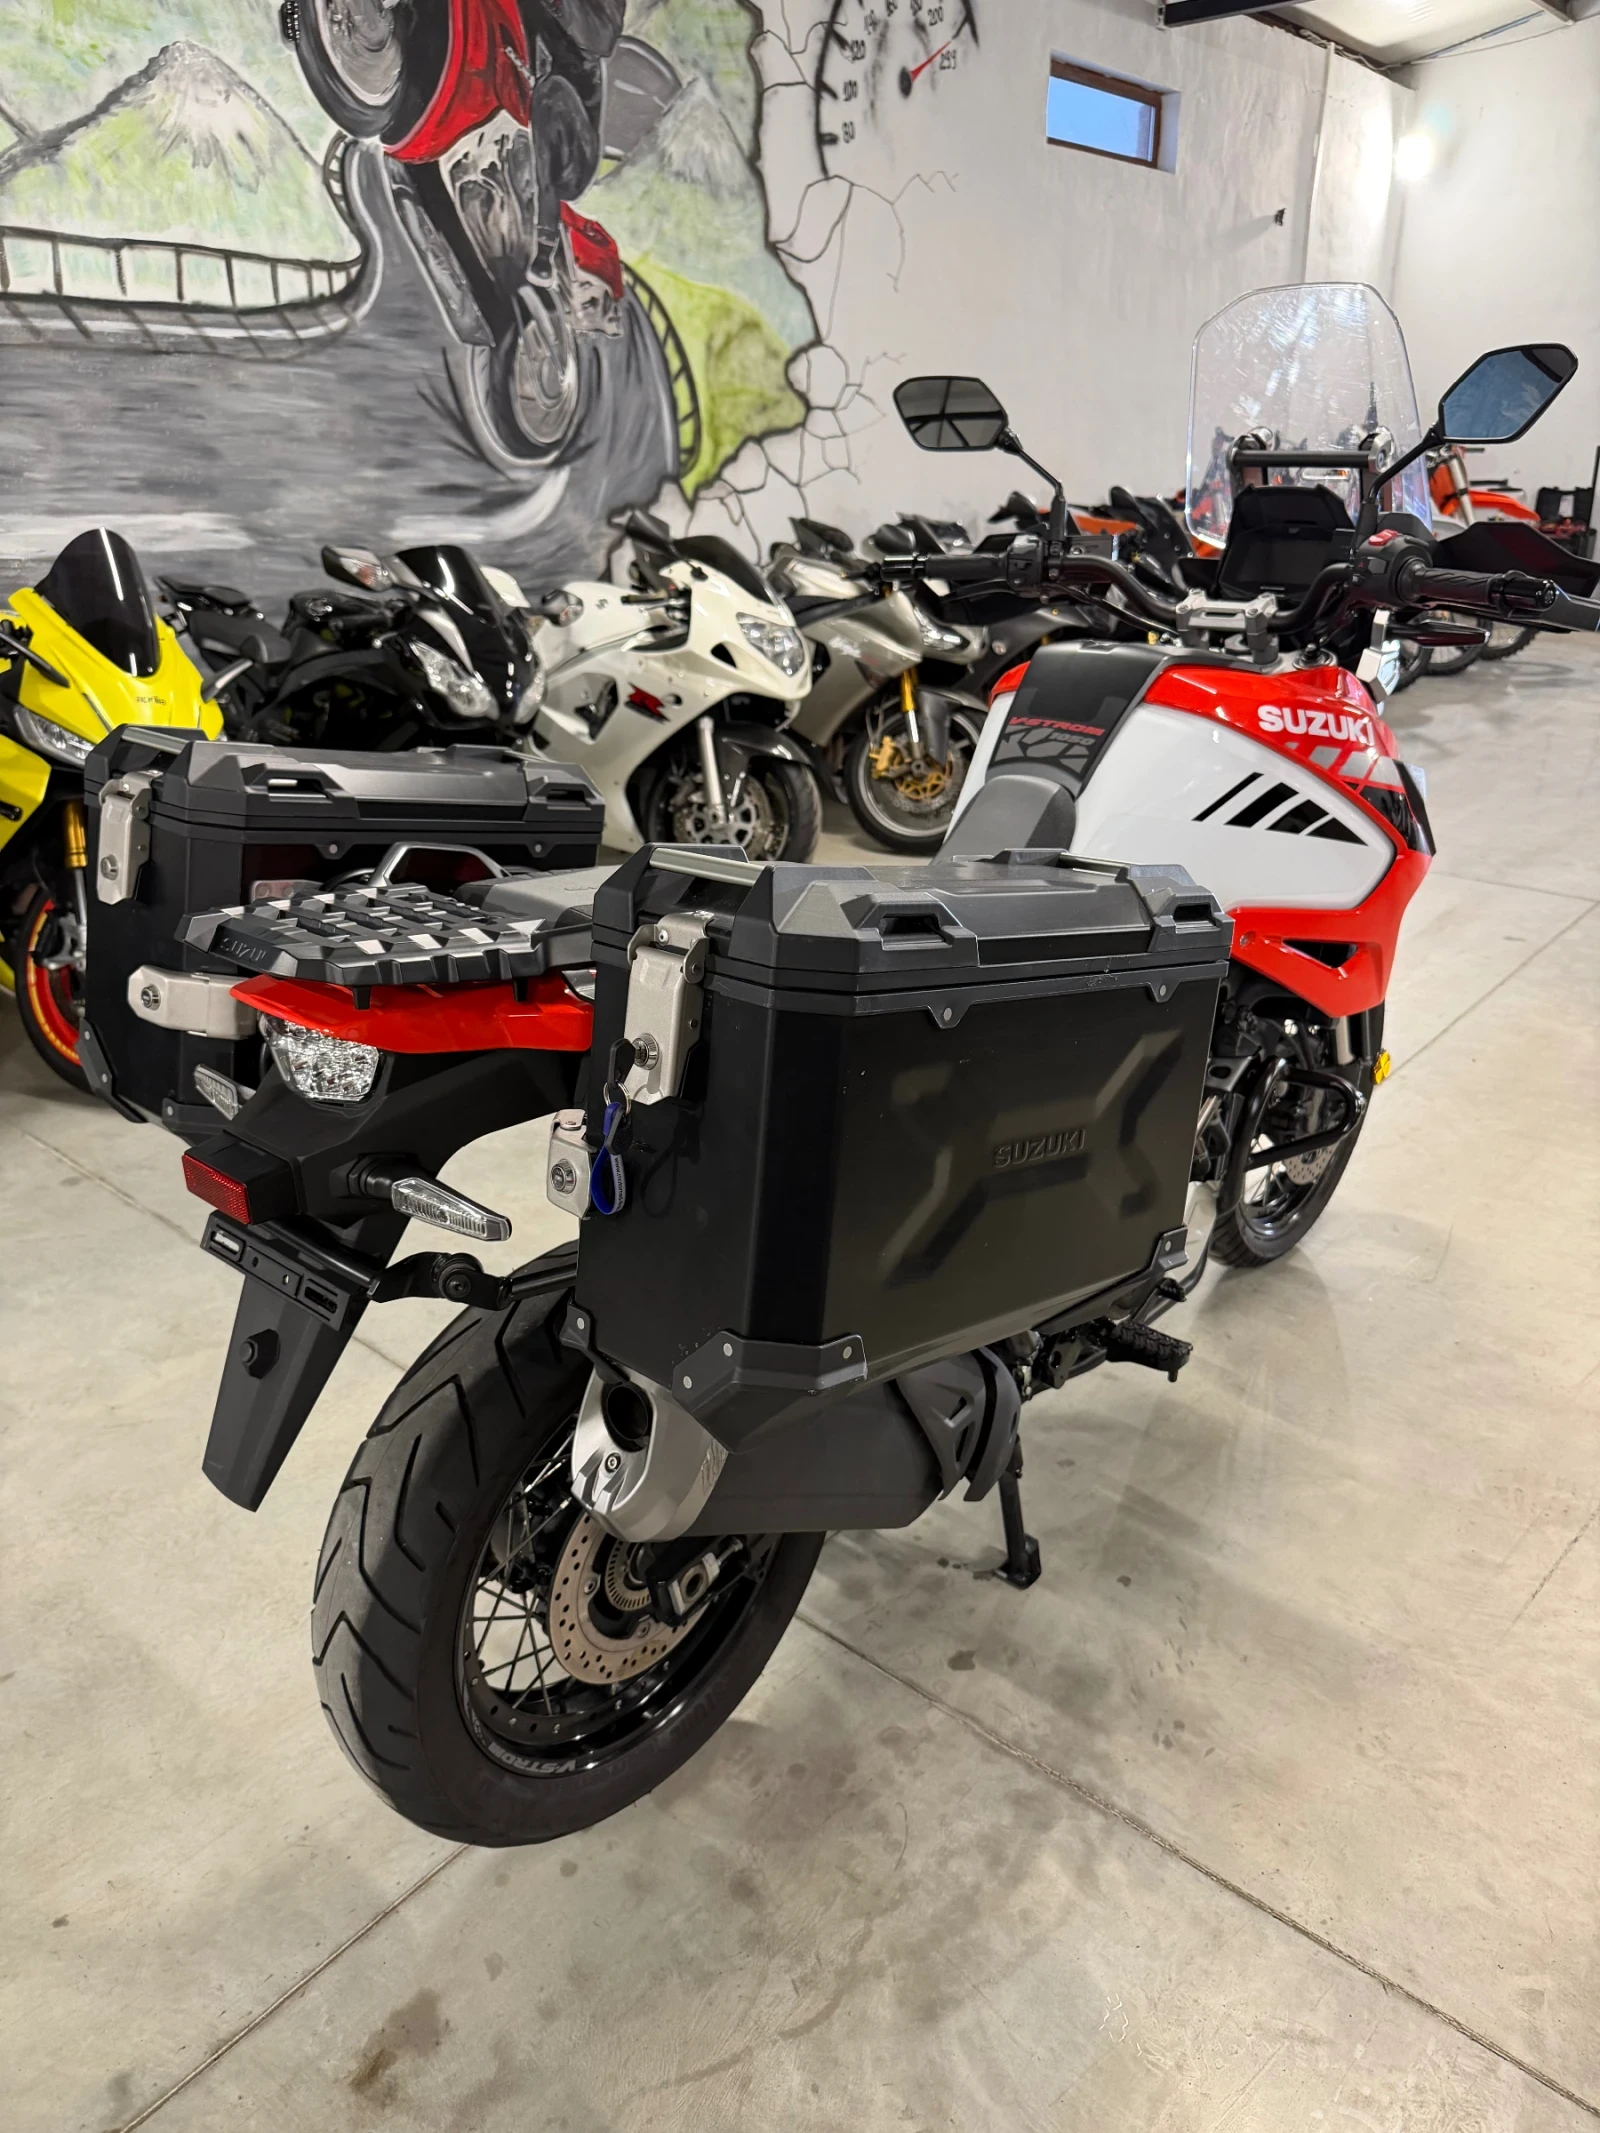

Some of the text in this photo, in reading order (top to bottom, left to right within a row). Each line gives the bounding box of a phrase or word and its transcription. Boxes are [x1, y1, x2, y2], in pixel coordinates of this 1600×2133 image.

[928, 6, 944, 27] 200
[1008, 716, 1105, 737] V-STROM
[1257, 704, 1375, 746] SUZUKI
[994, 1127, 1086, 1169] SUZUKI
[487, 1741, 577, 1774] V-STROM
